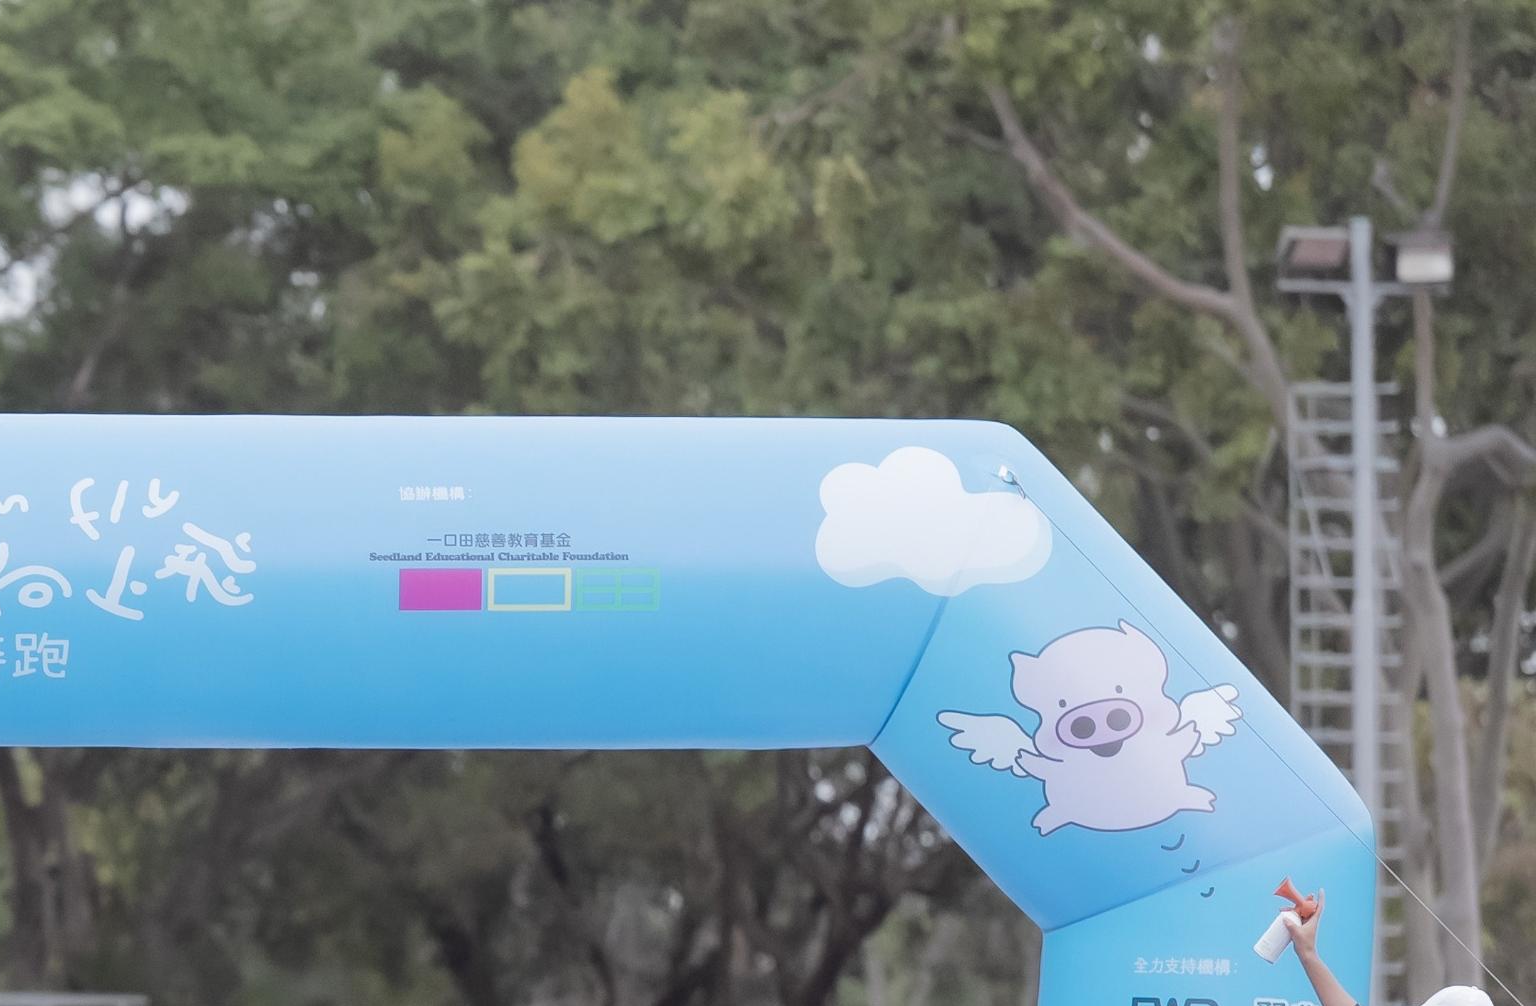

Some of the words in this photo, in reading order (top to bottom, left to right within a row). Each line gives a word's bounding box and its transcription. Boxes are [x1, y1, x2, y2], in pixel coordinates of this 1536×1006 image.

[69, 477, 180, 541] fly
[427, 532, 572, 548] 一口田慈善教育基金
[369, 551, 423, 562] Seedland
[425, 552, 495, 562] Educational
[498, 551, 560, 562] Charitable
[562, 551, 630, 562] Foundation
